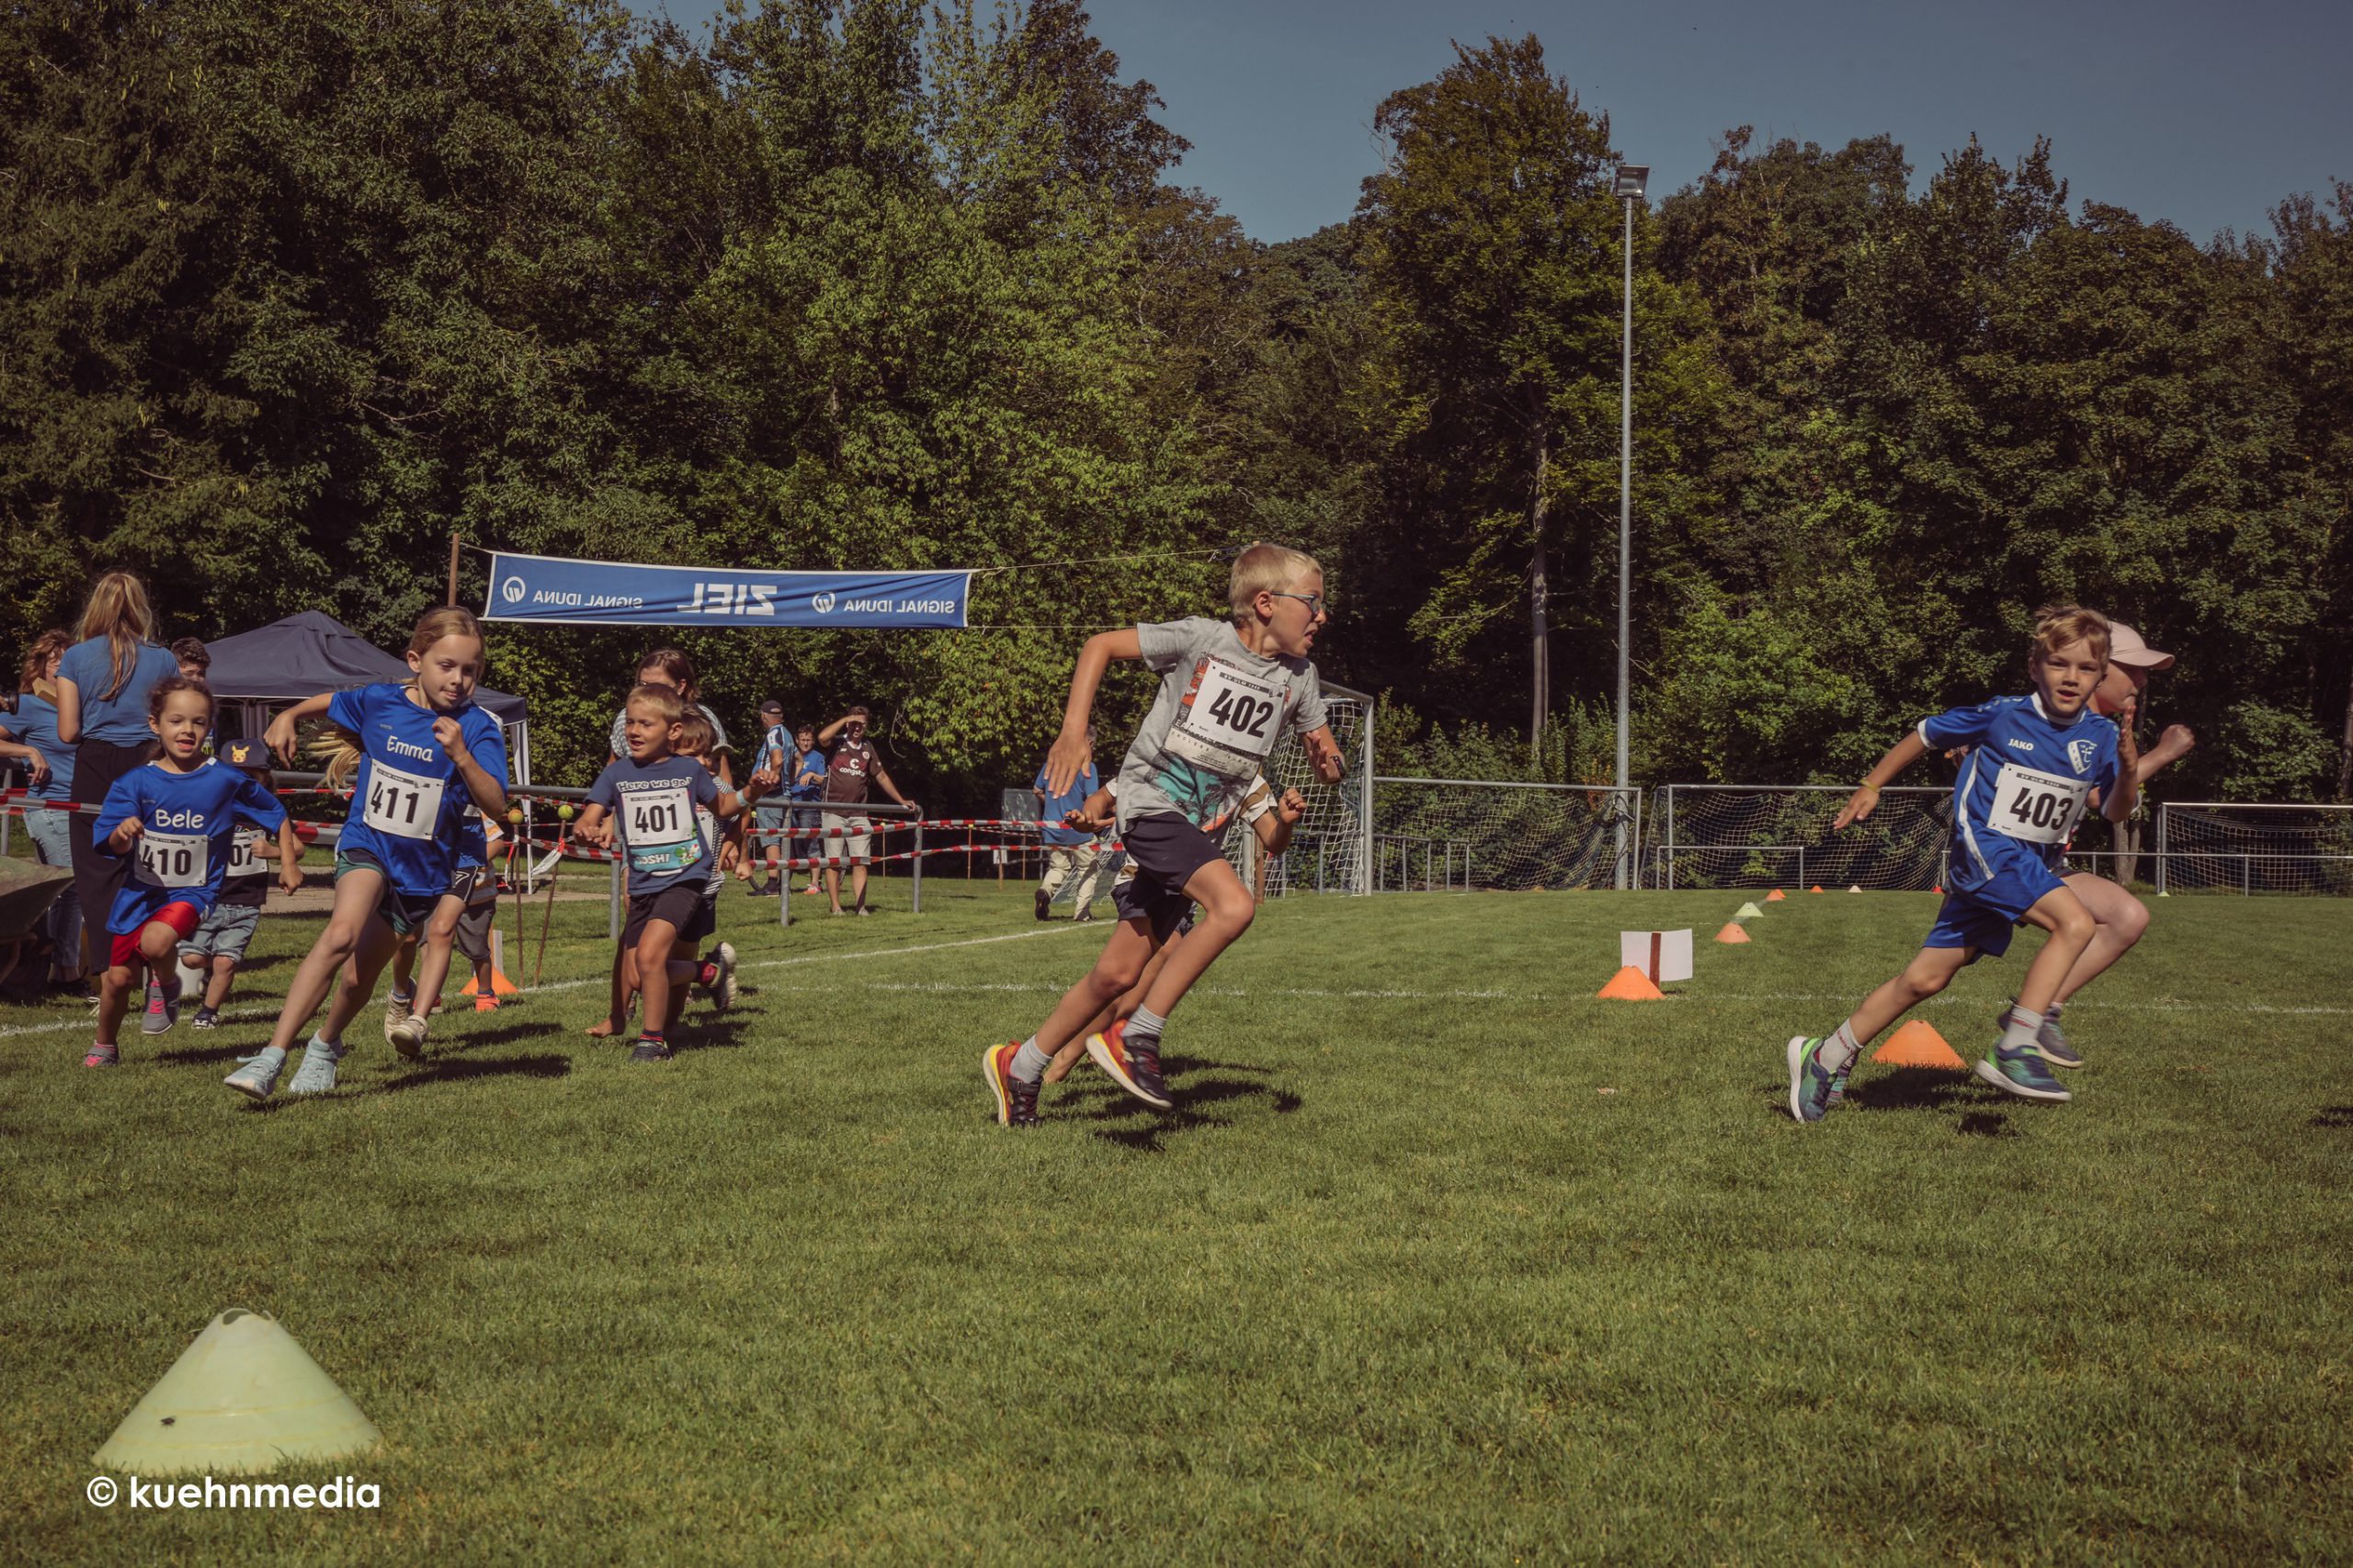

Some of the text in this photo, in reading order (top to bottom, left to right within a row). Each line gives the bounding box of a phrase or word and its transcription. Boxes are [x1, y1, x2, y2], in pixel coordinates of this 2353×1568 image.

[1209, 687, 1274, 738] 402
[387, 735, 434, 762] Emma
[2008, 739, 2034, 751] JAKO
[616, 780, 650, 792] Here
[650, 779, 670, 789] we
[370, 780, 419, 824] 411
[2009, 787, 2074, 831] 403
[155, 809, 204, 829] Bele
[635, 803, 678, 834] 401
[142, 845, 192, 876] 410
[229, 844, 254, 867] 07
